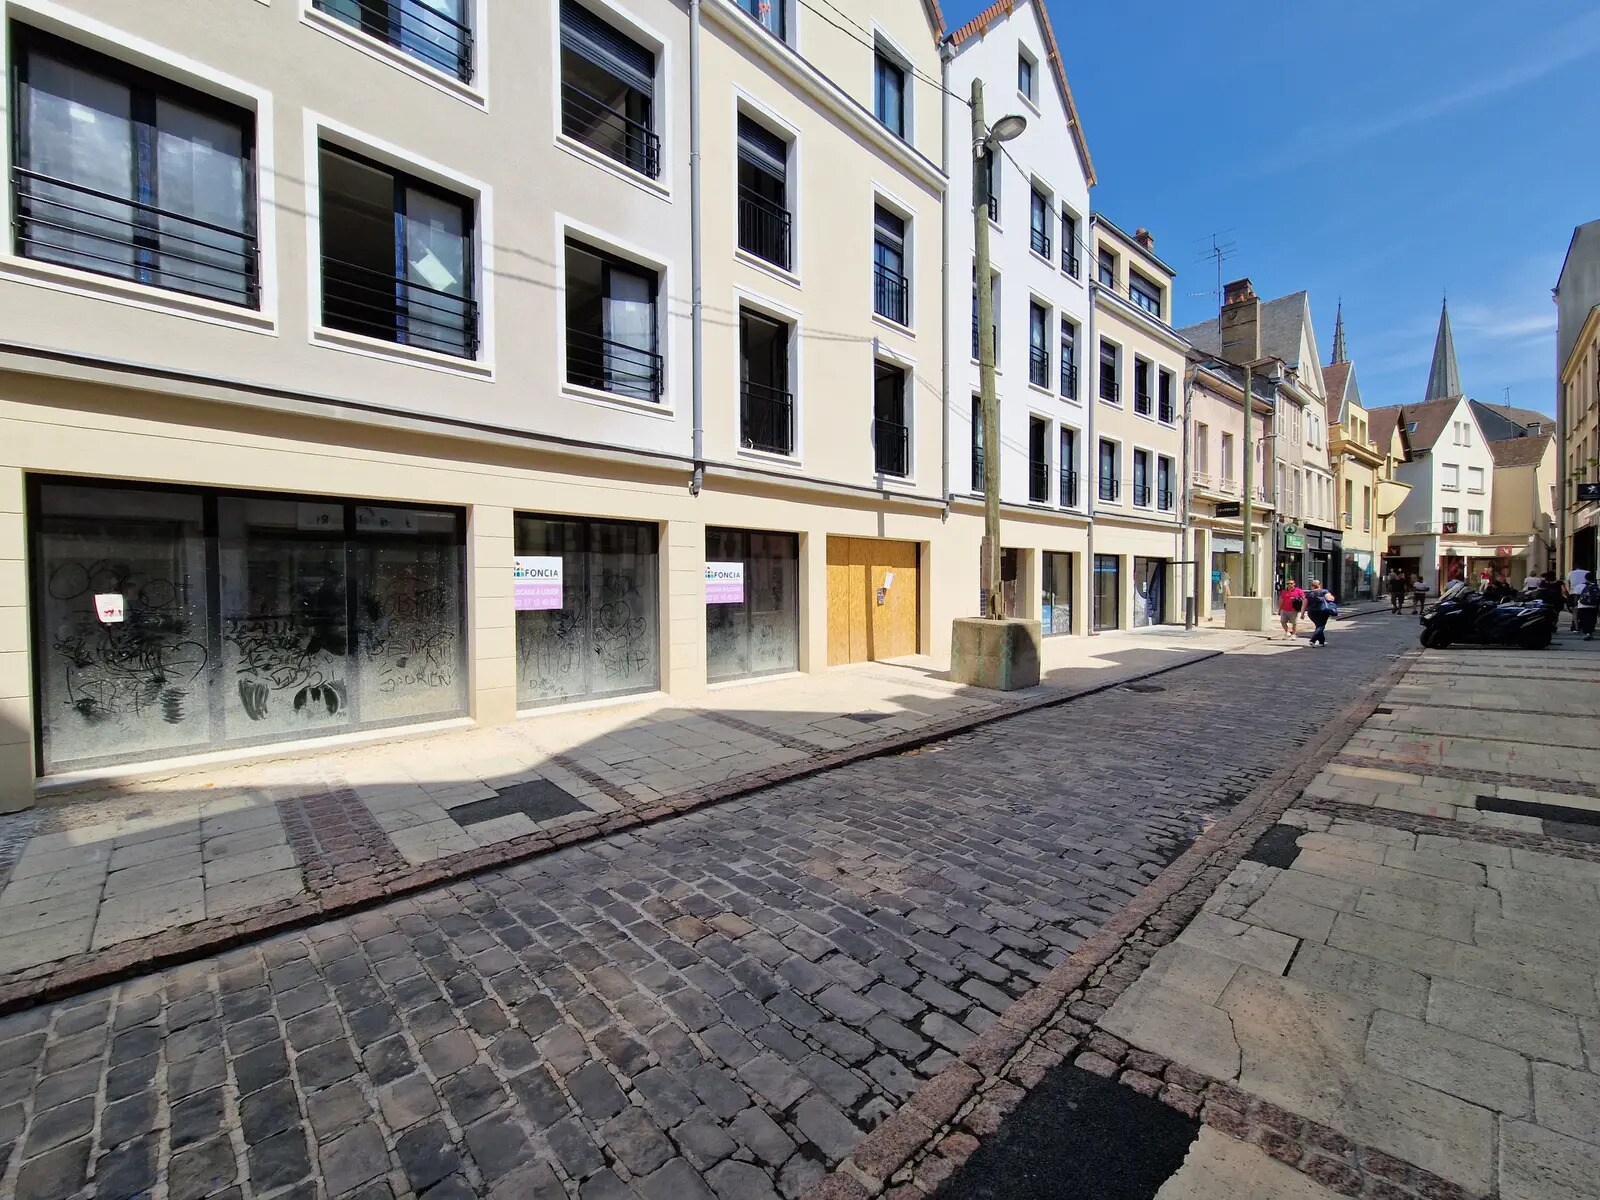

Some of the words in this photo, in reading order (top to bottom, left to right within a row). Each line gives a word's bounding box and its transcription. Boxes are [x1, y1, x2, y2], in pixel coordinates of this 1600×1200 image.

[524, 568, 559, 578] FONCIA
[713, 571, 741, 579] FONCIA
[514, 588, 535, 596] OCAUX
